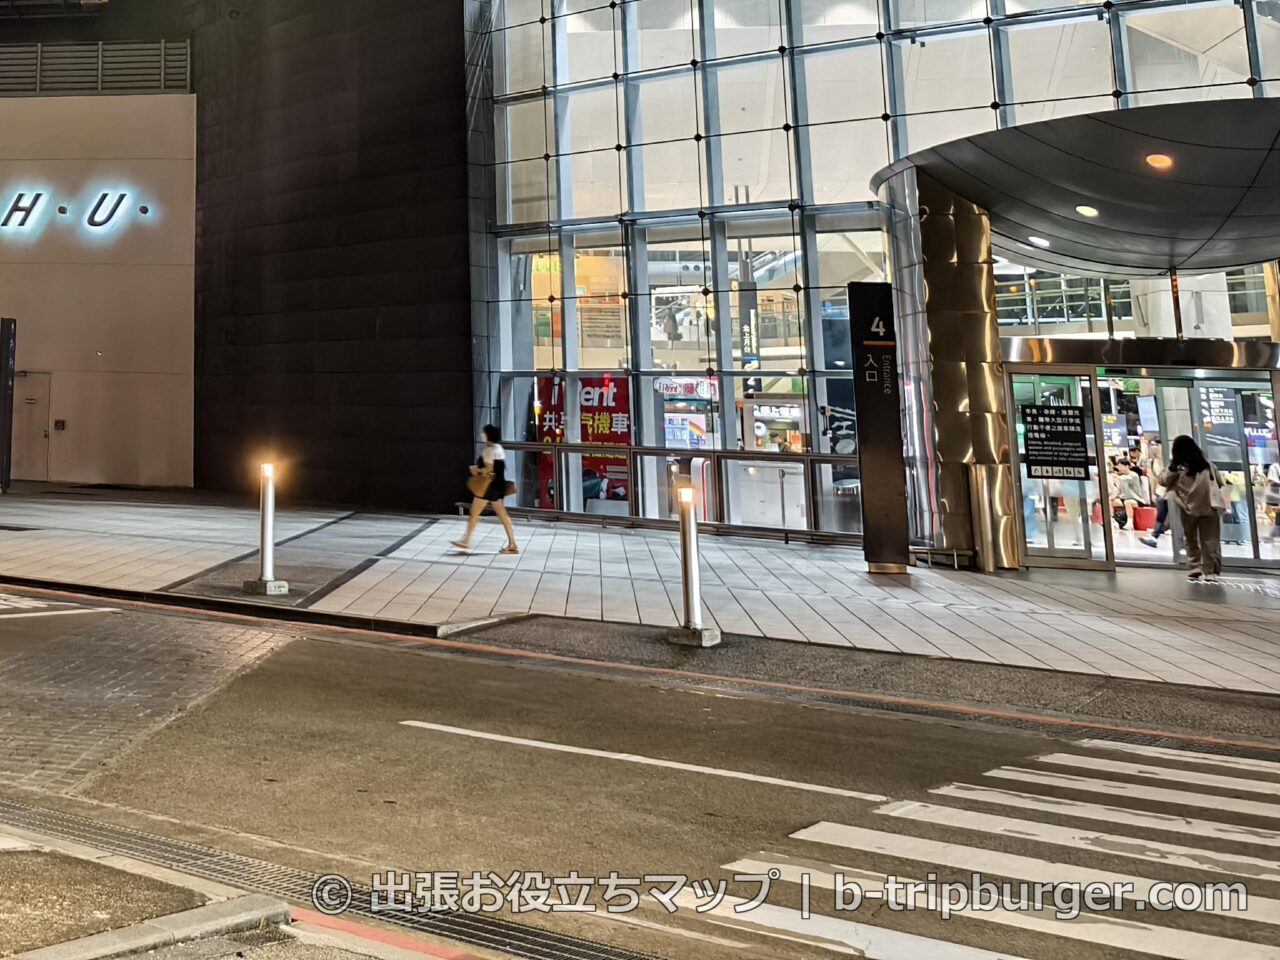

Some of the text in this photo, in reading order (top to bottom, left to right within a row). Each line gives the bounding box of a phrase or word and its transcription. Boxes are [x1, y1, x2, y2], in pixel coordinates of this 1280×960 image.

[870, 316, 886, 337] 4
[864, 354, 879, 382] 入口
[882, 354, 892, 394] Entrance
[551, 377, 617, 407] ient
